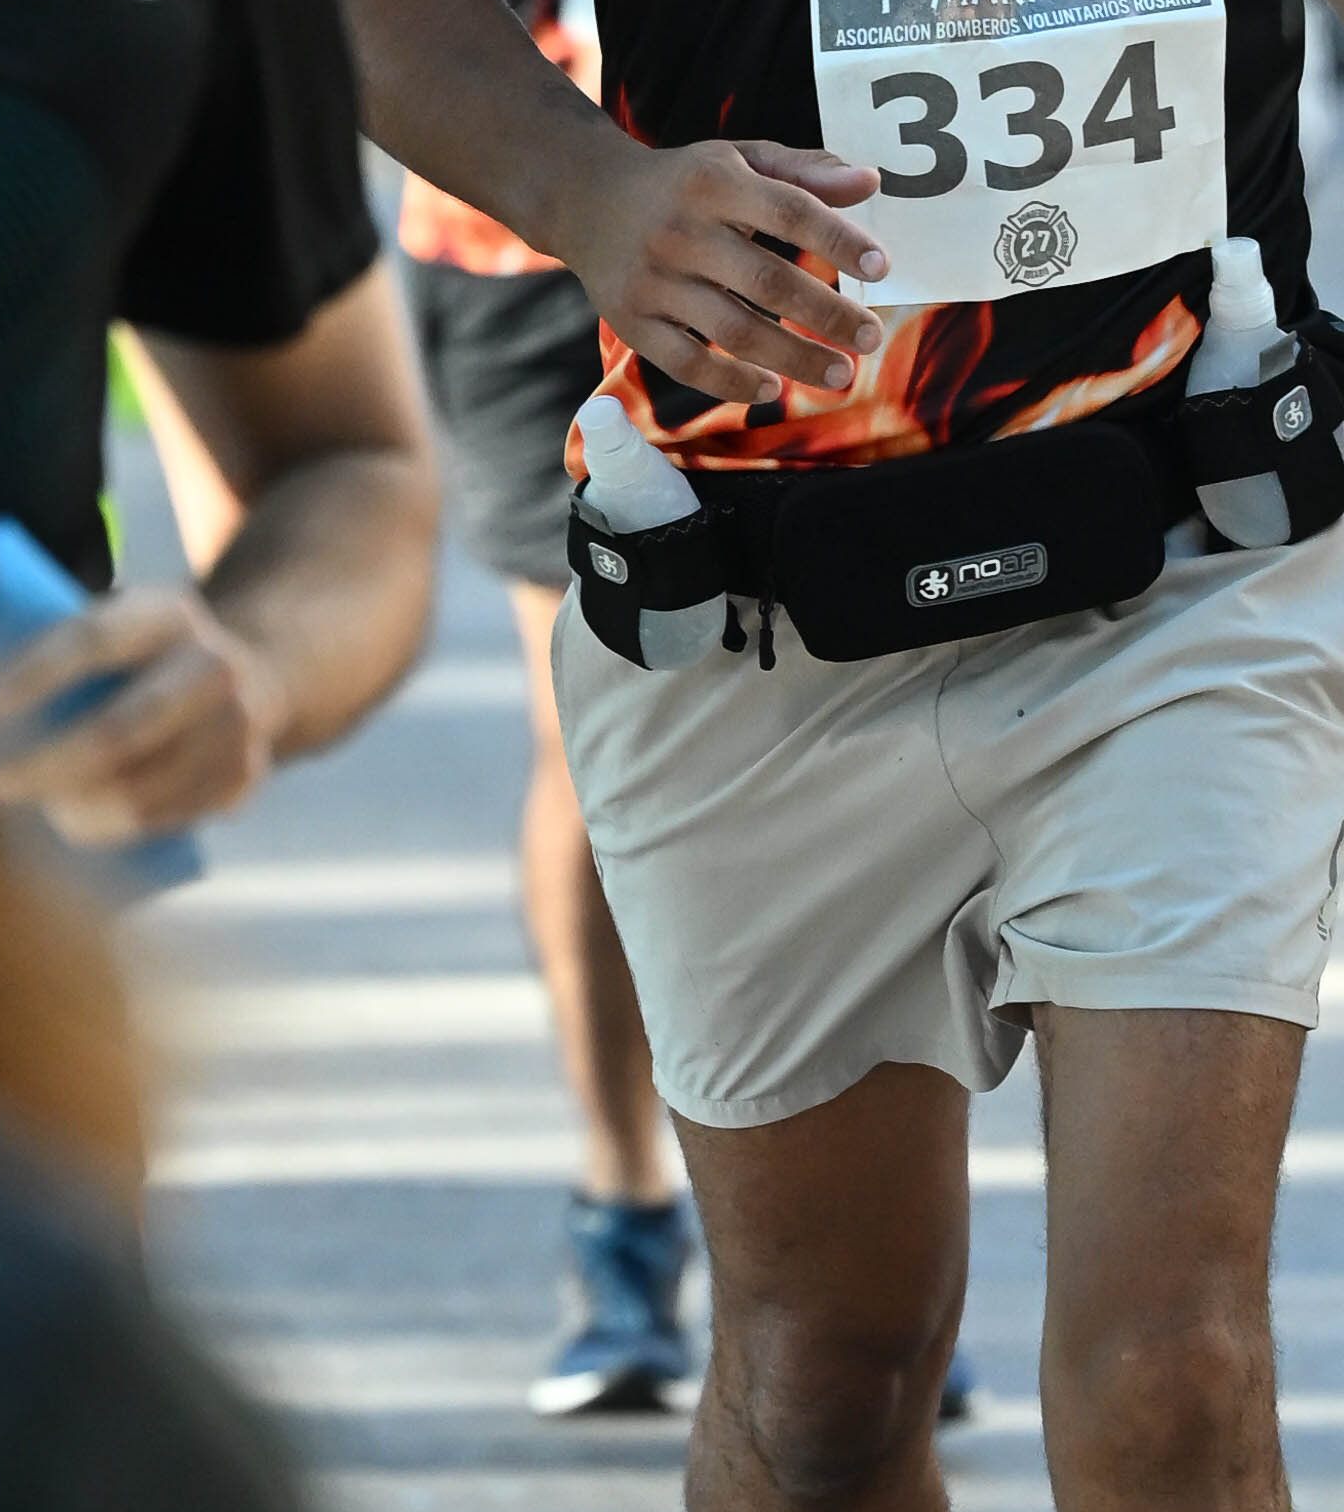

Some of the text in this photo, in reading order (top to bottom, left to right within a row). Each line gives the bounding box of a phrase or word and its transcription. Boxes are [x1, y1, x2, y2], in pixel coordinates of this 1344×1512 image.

[836, 20, 931, 47] ASOCIACIÓN
[936, 17, 1021, 40] BOMBEROS
[1022, 0, 1131, 31] VOLUNTARIOS
[868, 40, 1176, 200] 334
[1020, 229, 1051, 259] 27
